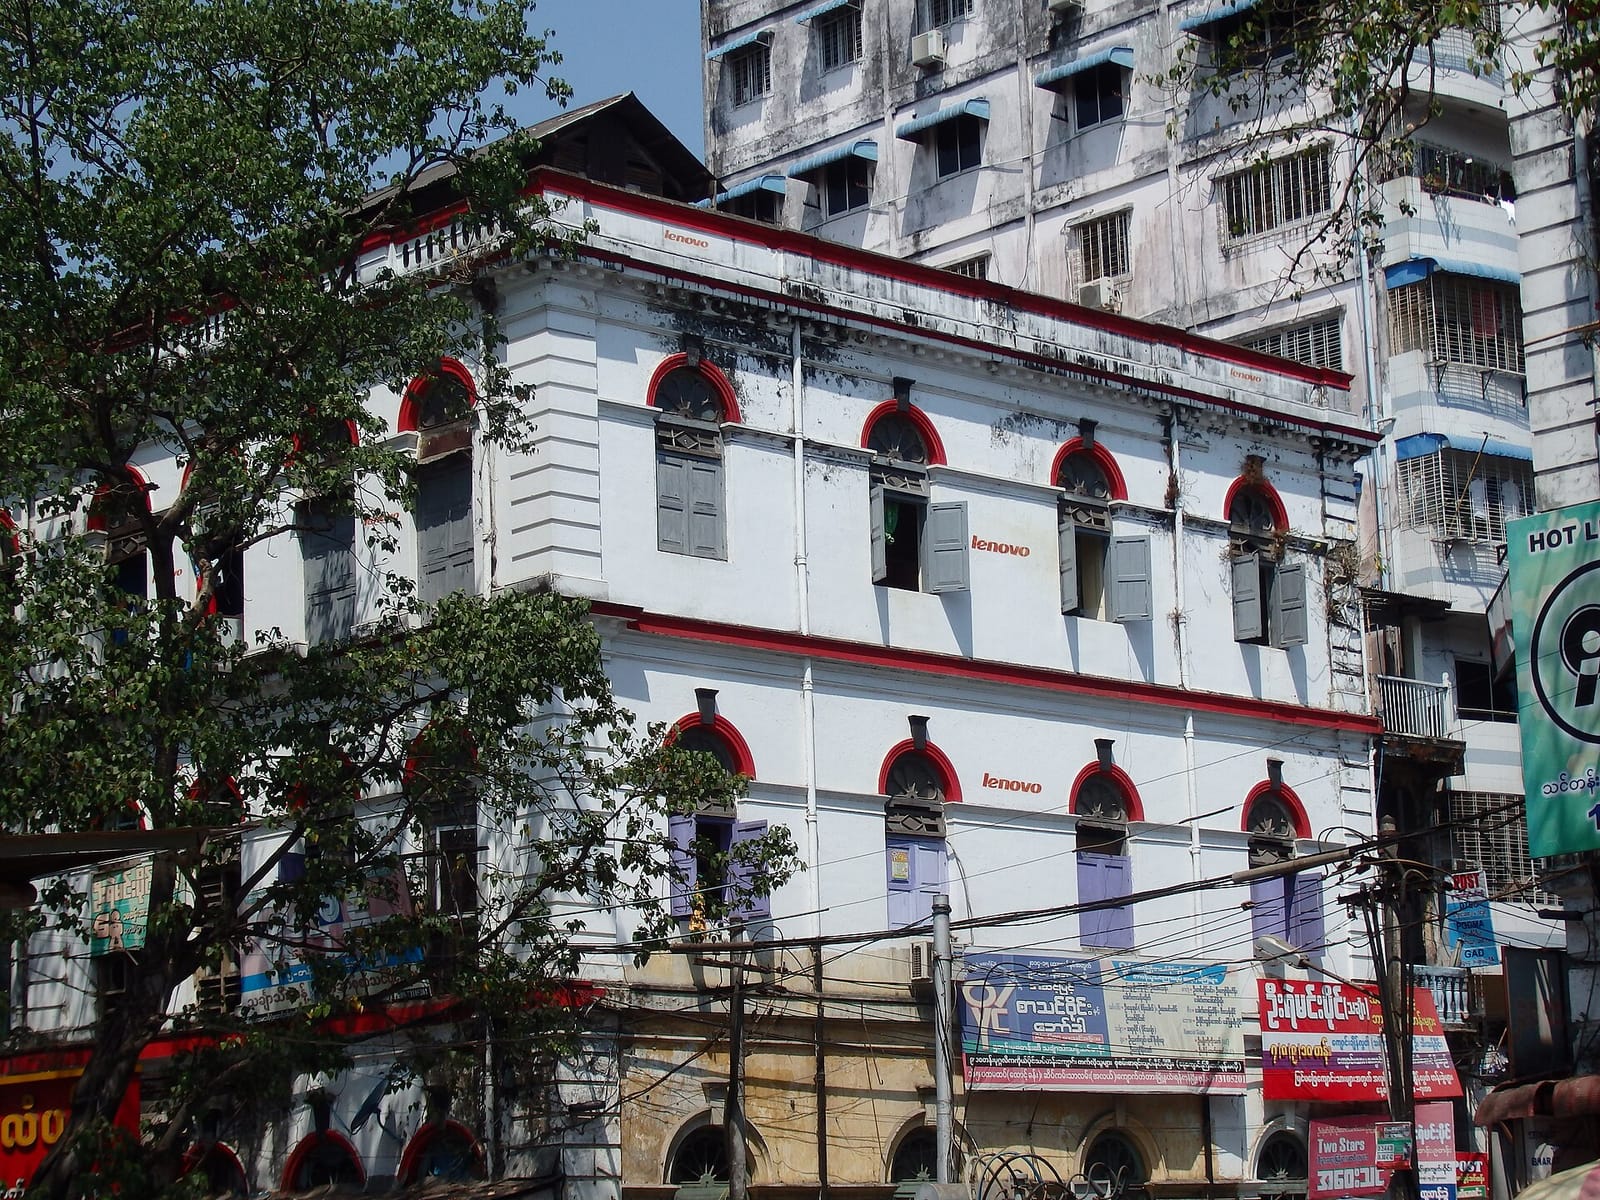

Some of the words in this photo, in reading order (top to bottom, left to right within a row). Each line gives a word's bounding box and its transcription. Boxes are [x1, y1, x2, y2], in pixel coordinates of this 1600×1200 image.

[664, 230, 709, 248] lenovo
[1231, 368, 1261, 382] lenovo
[971, 535, 1030, 557] lenovo
[1529, 525, 1576, 552] HOT
[1585, 522, 1600, 541] L
[982, 773, 1042, 793] lenovo
[1465, 949, 1484, 958] GAD
[1317, 1139, 1337, 1153] Two
[1340, 1137, 1365, 1152] Stars
